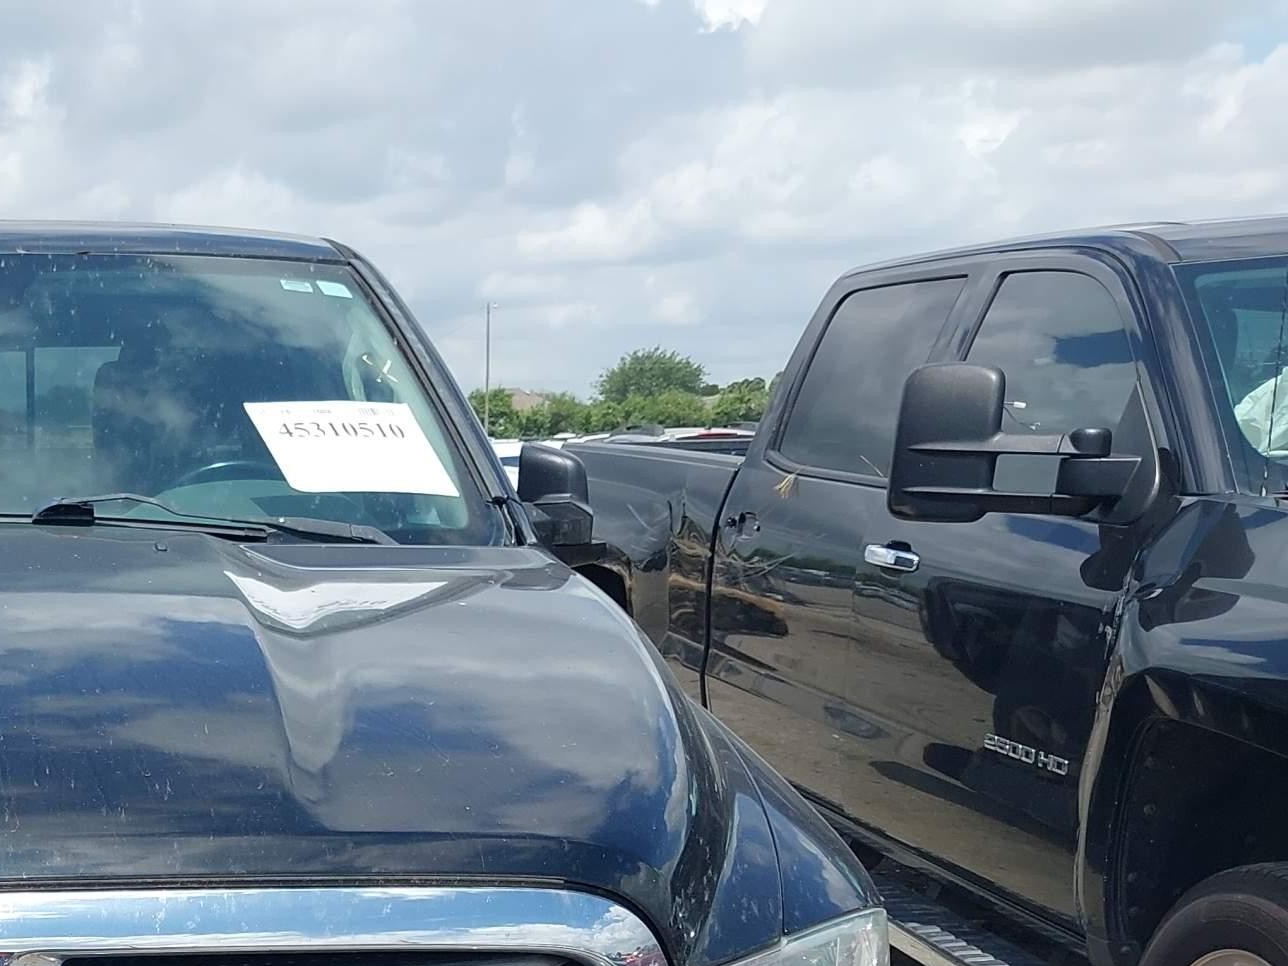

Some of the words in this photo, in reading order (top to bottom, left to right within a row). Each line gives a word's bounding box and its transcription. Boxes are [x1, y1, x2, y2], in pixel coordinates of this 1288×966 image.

[278, 422, 406, 439] 45310510
[983, 733, 1035, 763] 2500
[1038, 751, 1068, 775] HD
